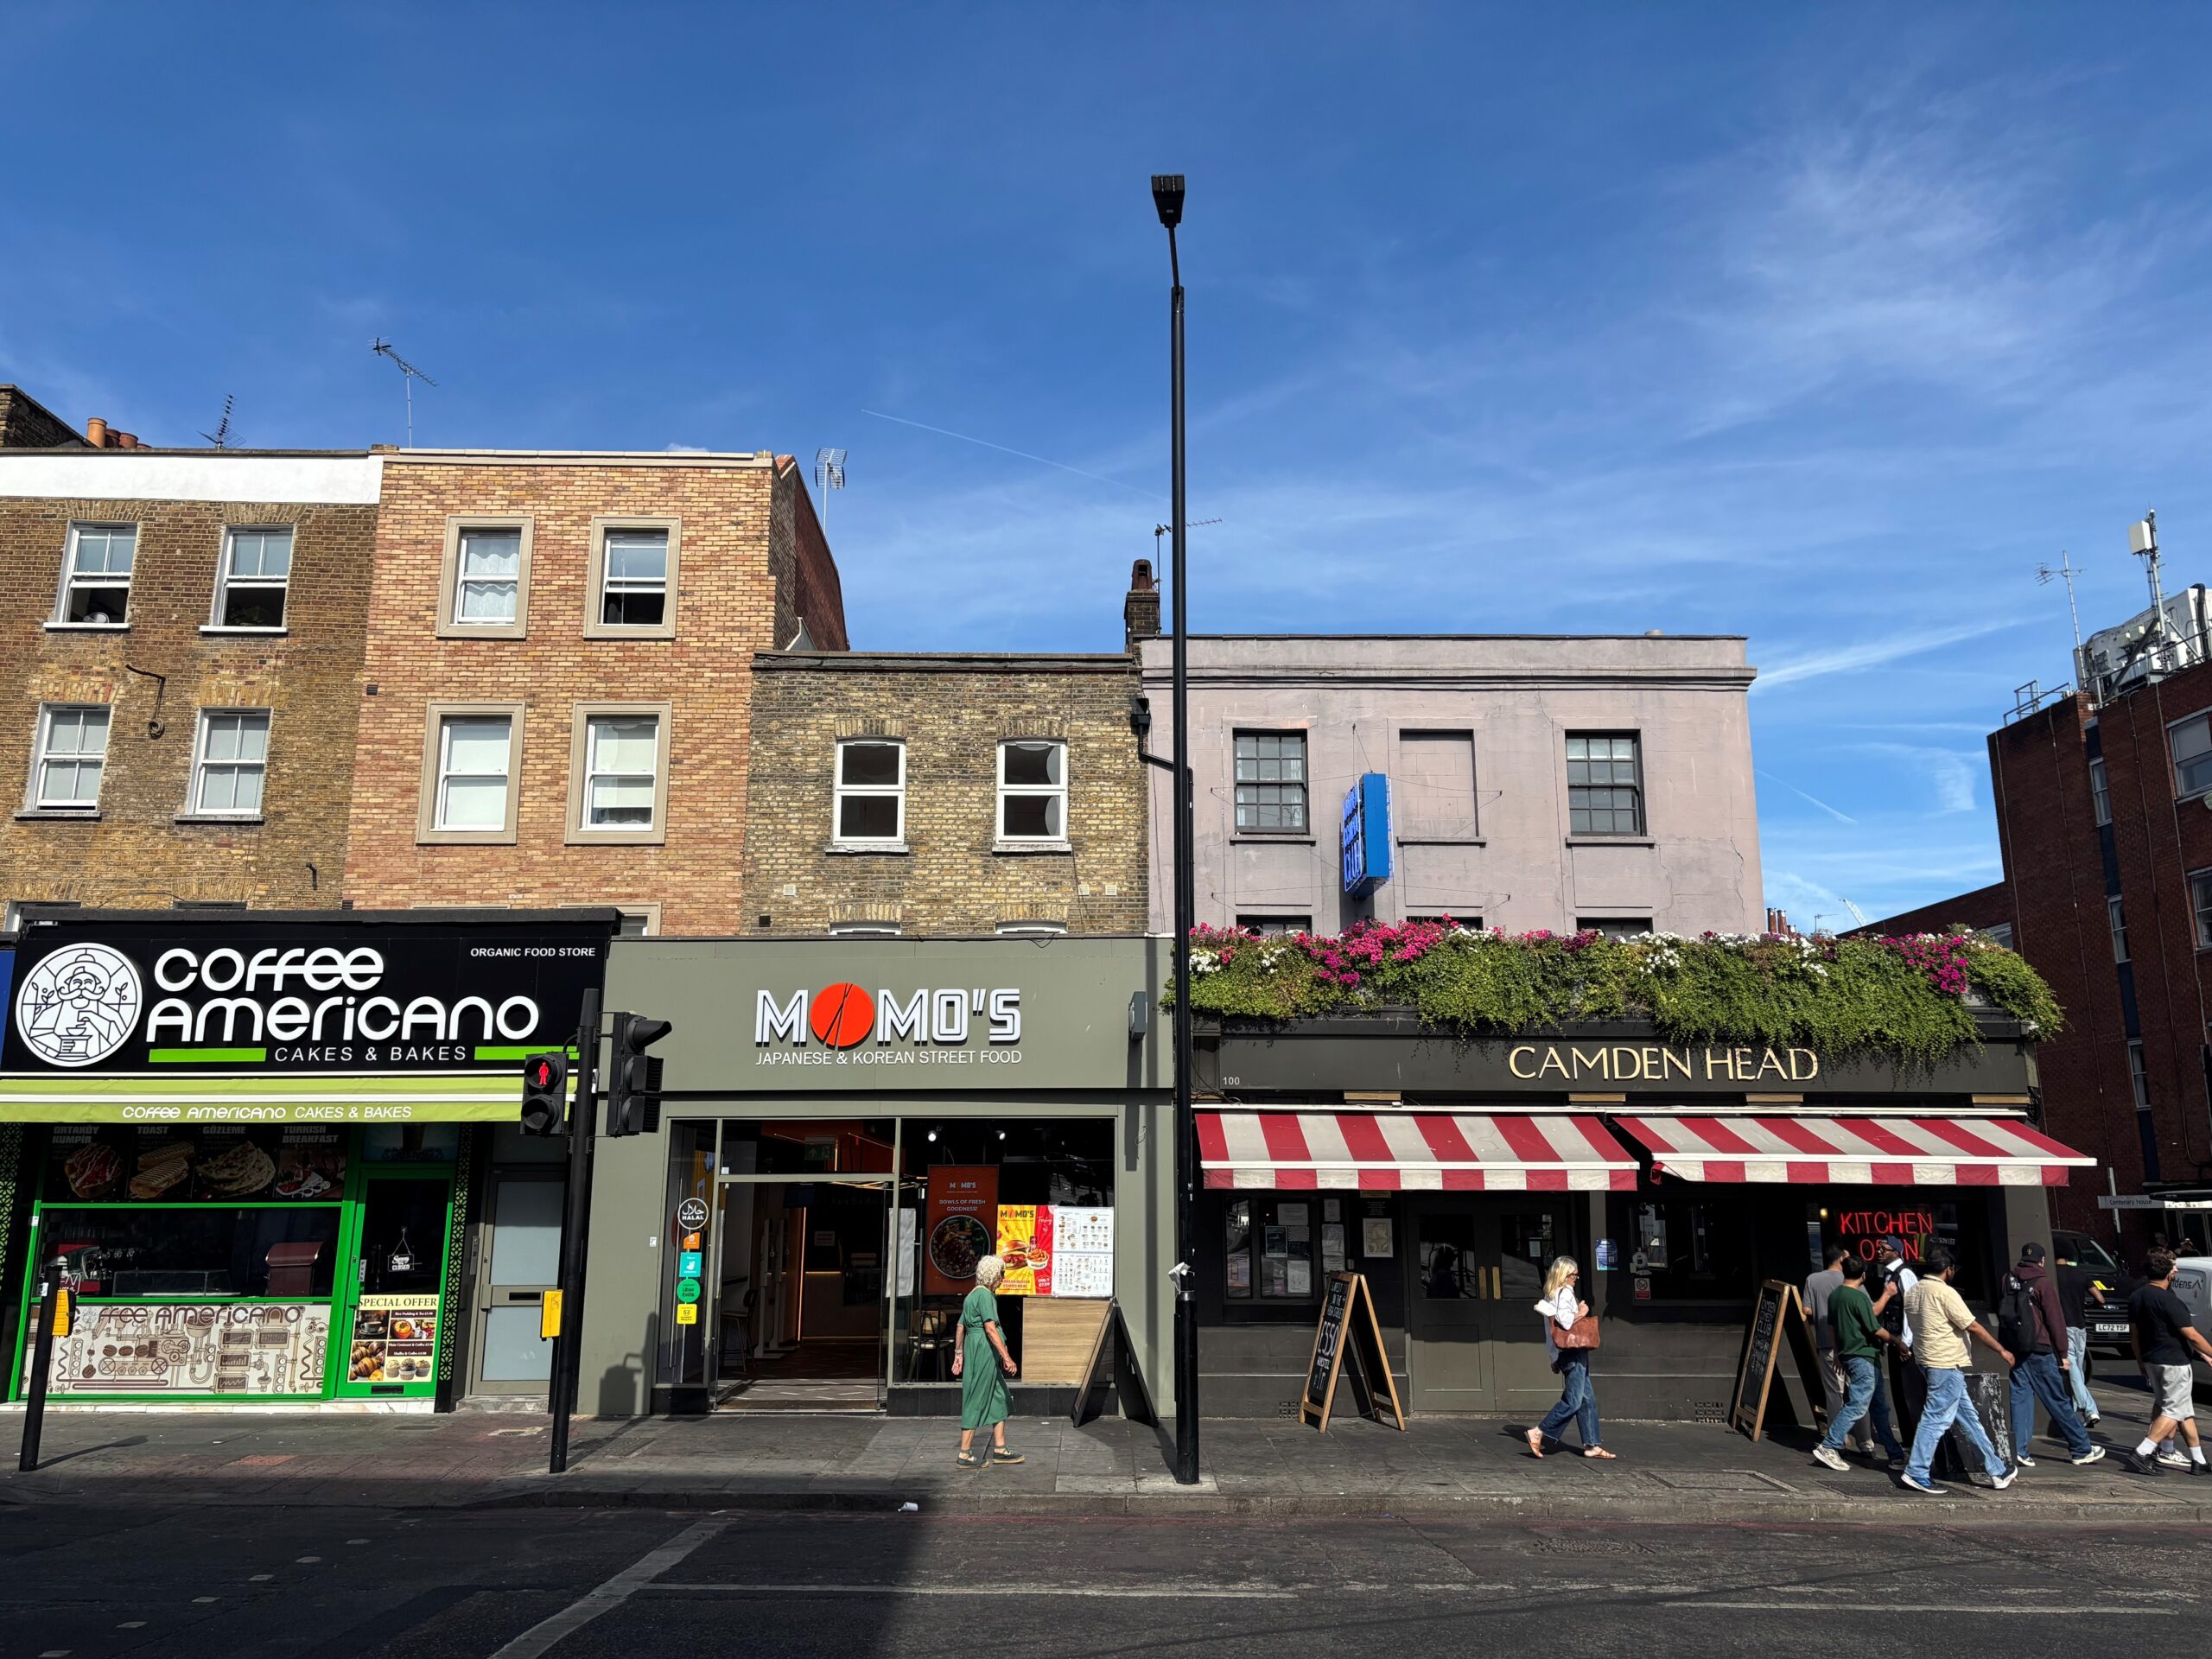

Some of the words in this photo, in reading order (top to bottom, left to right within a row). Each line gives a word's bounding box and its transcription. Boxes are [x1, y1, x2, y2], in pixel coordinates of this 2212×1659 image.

[470, 948, 521, 957] ORGANIC
[524, 948, 556, 957] FOOD
[558, 948, 595, 957] STORE
[275, 1047, 353, 1062] CAKES
[365, 1046, 378, 1061] &
[390, 1046, 467, 1061] BAKES
[755, 1052, 832, 1065] JAPANESE
[836, 1052, 849, 1065] &
[853, 1051, 915, 1065] KOREAN
[919, 1051, 976, 1064] STREET
[980, 1051, 1022, 1064] FOOD
[1509, 1046, 1693, 1080] CAMDEN
[1705, 1047, 1819, 1080] HEAD
[1223, 1076, 1240, 1085] 100
[295, 1106, 344, 1118] CAKES
[348, 1107, 359, 1118] &
[363, 1106, 412, 1118] BAKES
[137, 1126, 169, 1135] TOAST
[202, 1124, 247, 1135] GÖZLEME
[283, 1125, 327, 1135] TURKISH
[282, 1135, 339, 1144] BREAKFAST
[682, 1203, 704, 1216] حلال
[1840, 1211, 1934, 1234] KITCHEN
[1859, 1238, 1919, 1262] ON
[359, 1298, 401, 1306] SPECIAL
[404, 1298, 437, 1306] OFFER
